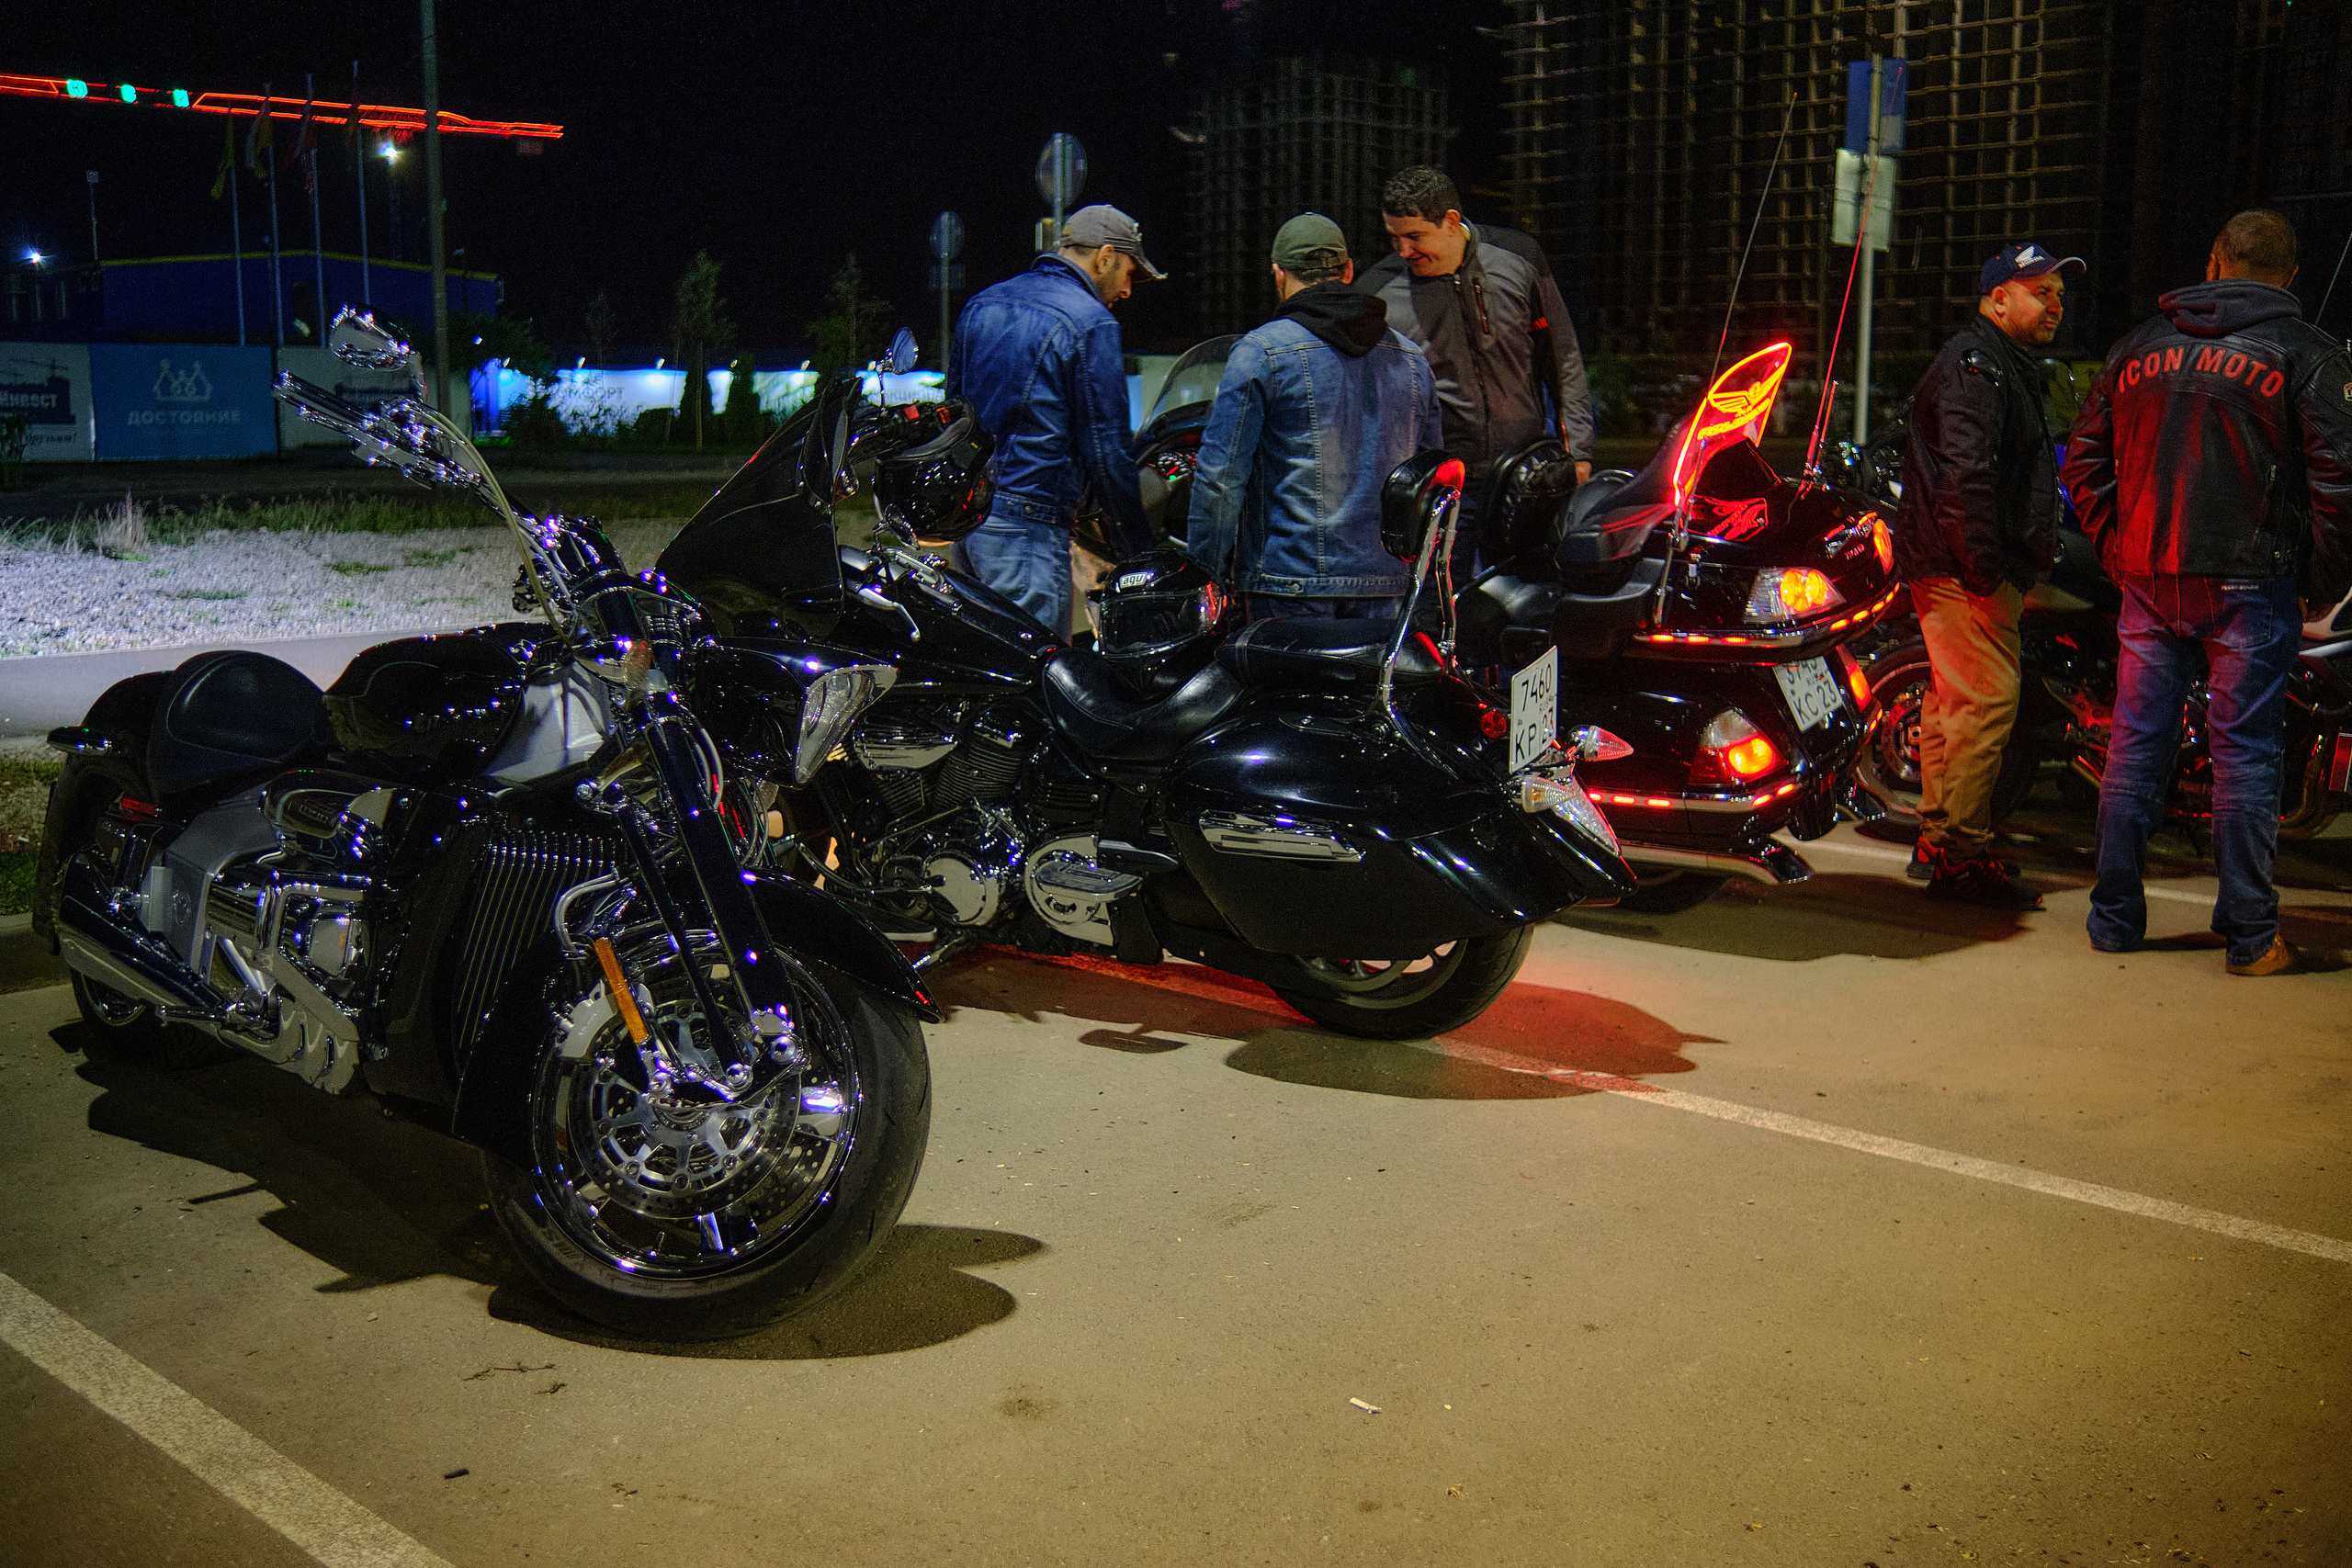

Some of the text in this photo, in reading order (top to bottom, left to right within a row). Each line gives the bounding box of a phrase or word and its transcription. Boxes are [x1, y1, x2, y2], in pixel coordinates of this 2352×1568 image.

[2119, 345, 2285, 398] ICON MOTO
[127, 410, 241, 425] ДОСТОЯНИЕ
[1521, 663, 1552, 712] 7460
[1816, 681, 1837, 708] 23
